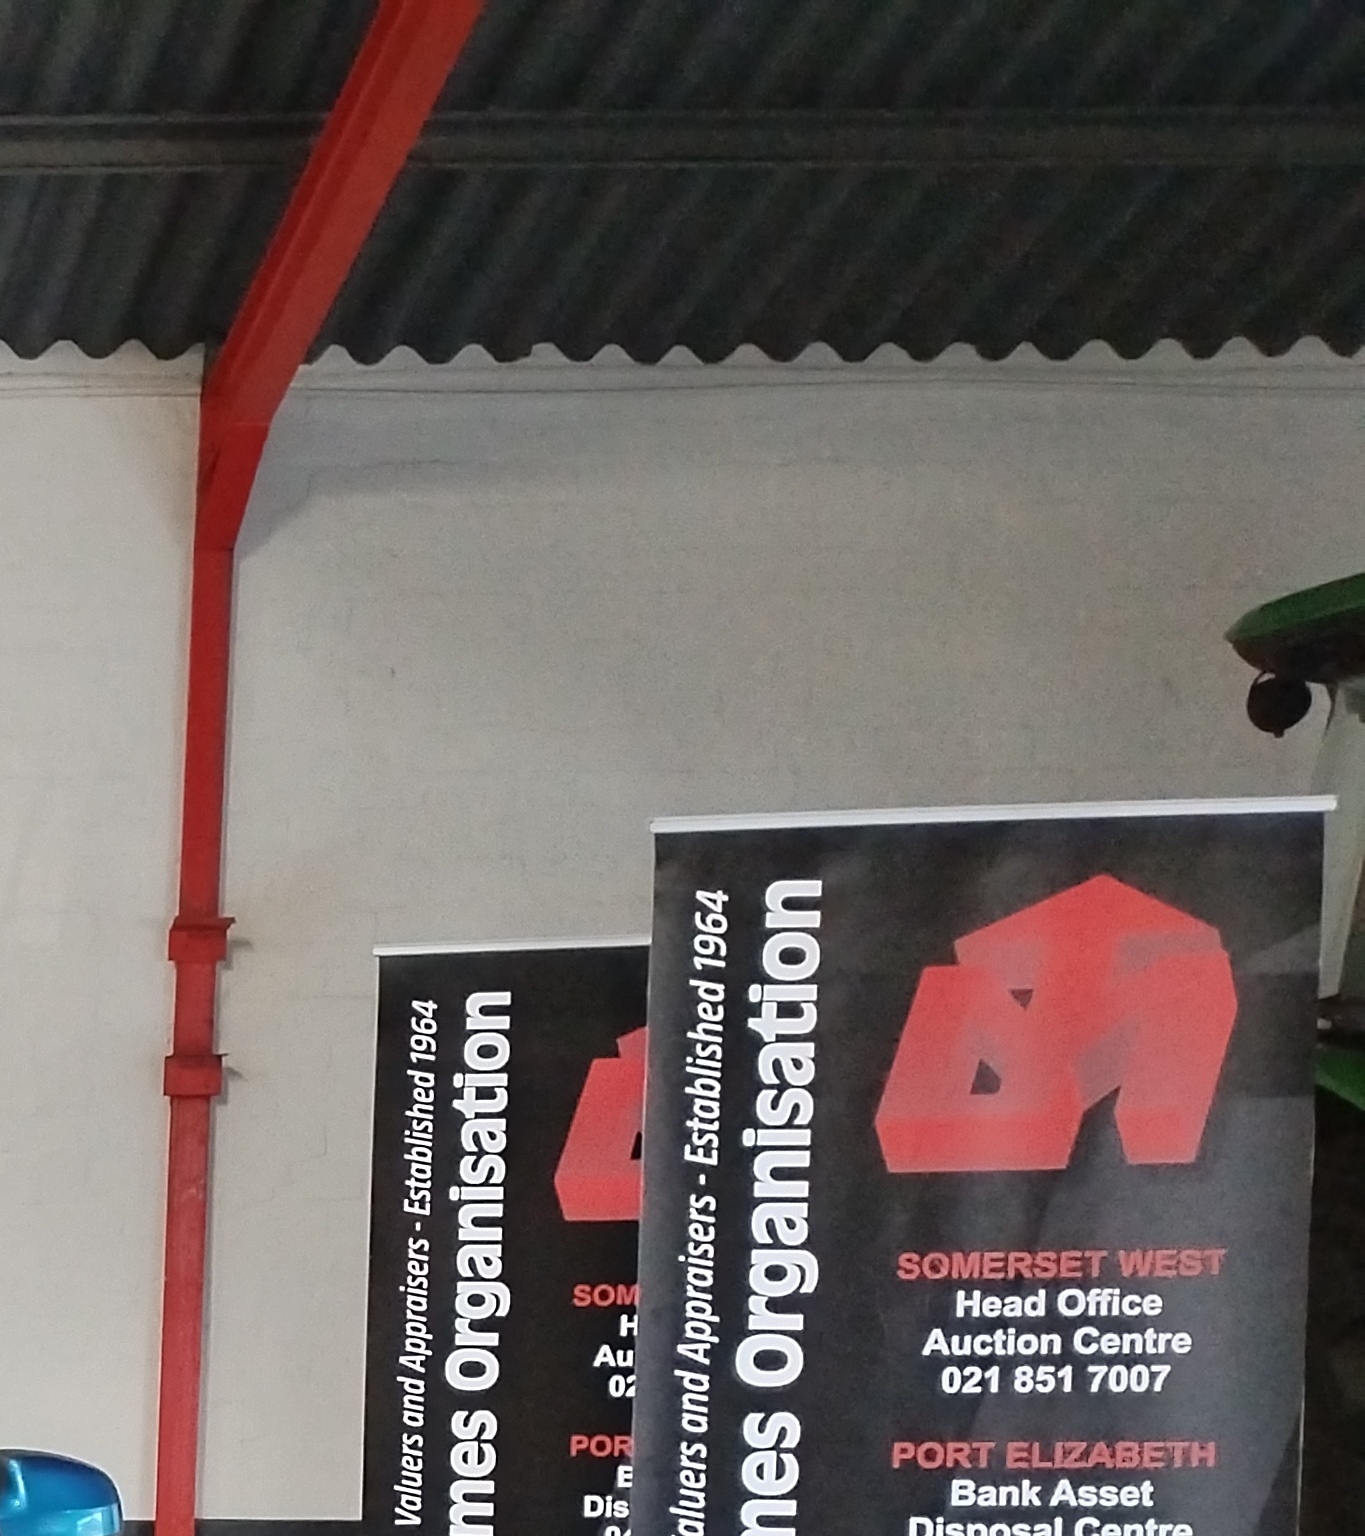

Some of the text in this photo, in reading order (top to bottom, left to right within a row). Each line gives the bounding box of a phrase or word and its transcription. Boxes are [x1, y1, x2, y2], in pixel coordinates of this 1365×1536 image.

[694, 891, 728, 964] 1964
[410, 1001, 437, 1062] 1964
[684, 979, 725, 1165] Established
[404, 1070, 434, 1214] Established
[735, 880, 822, 1387] Organisation
[445, 992, 511, 1391] Organisation
[699, 1174, 705, 1185] -
[416, 1222, 420, 1230] -
[677, 1194, 720, 1365] Appraisers
[899, 1249, 1223, 1280] SOMERSET WEST
[399, 1238, 433, 1365] Appraisers
[956, 1288, 1162, 1317] Head Office
[922, 1327, 1192, 1355] Auction Centre
[396, 1376, 425, 1427] and
[674, 1370, 709, 1432] and
[942, 1365, 1171, 1393] 021 851 7007
[570, 1435, 632, 1457] POR
[892, 1441, 1216, 1469] PORT ELIZABETH
[394, 1433, 423, 1525] Valuers
[951, 1479, 1153, 1506] Bank Asset
